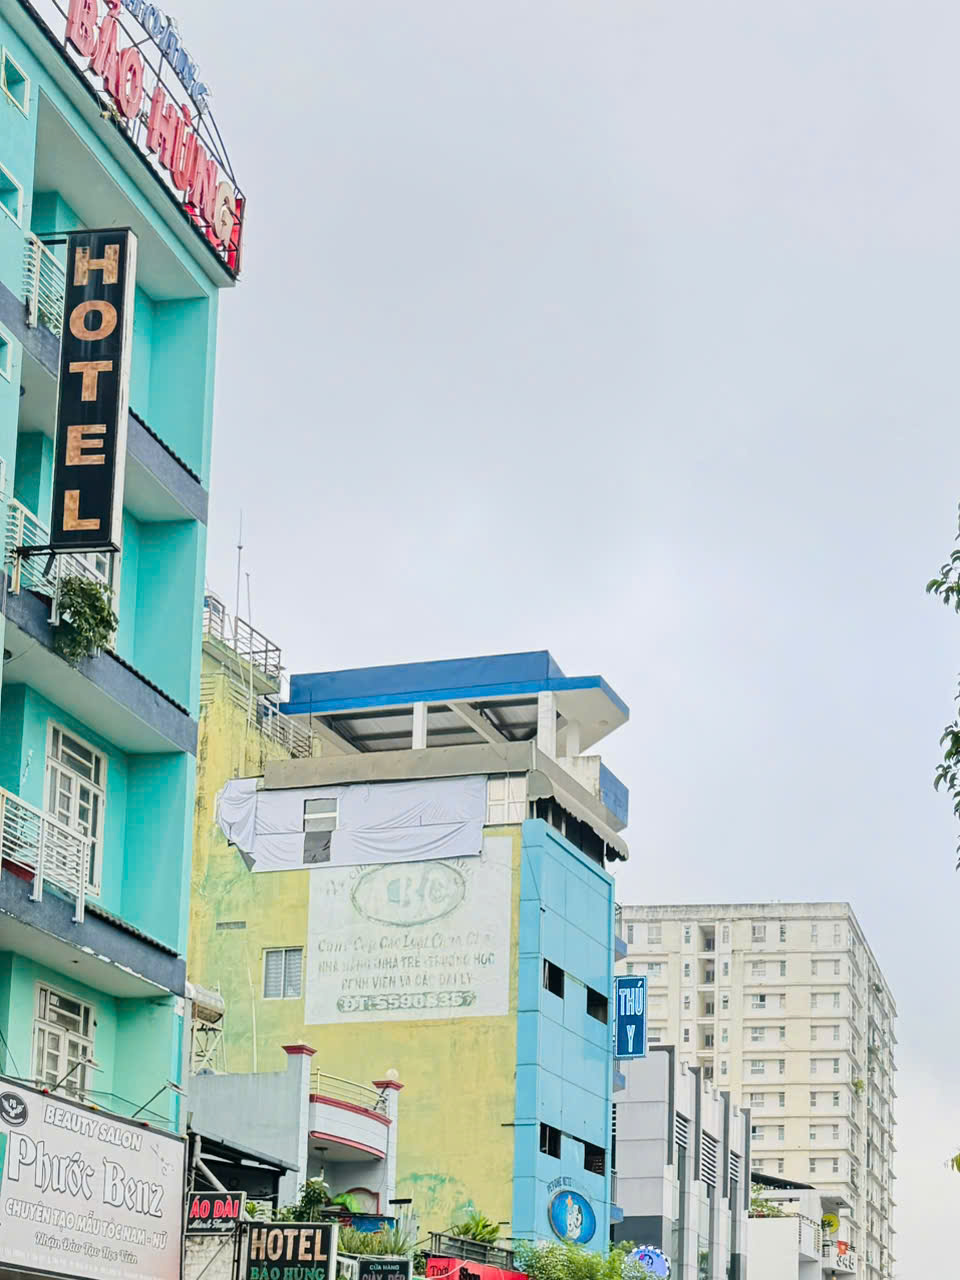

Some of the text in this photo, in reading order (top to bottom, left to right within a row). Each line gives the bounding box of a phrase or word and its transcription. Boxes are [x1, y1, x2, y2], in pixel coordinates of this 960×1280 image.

[146, 87, 236, 247] HÙNG
[62, 243, 120, 531] HOTEL
[619, 980, 643, 1016] THÚ
[626, 1025, 636, 1053] Y
[44, 1104, 143, 1151] BEAUTY SALON
[8, 1130, 165, 1218] Phước Benz
[5, 1198, 52, 1225] CHUYÊN
[51, 1208, 75, 1233] TẠO
[122, 1222, 147, 1246] NAM
[190, 1195, 239, 1218] ÁO DÀI
[250, 1228, 328, 1261] HOTEL
[250, 1261, 281, 1280] BẢO
